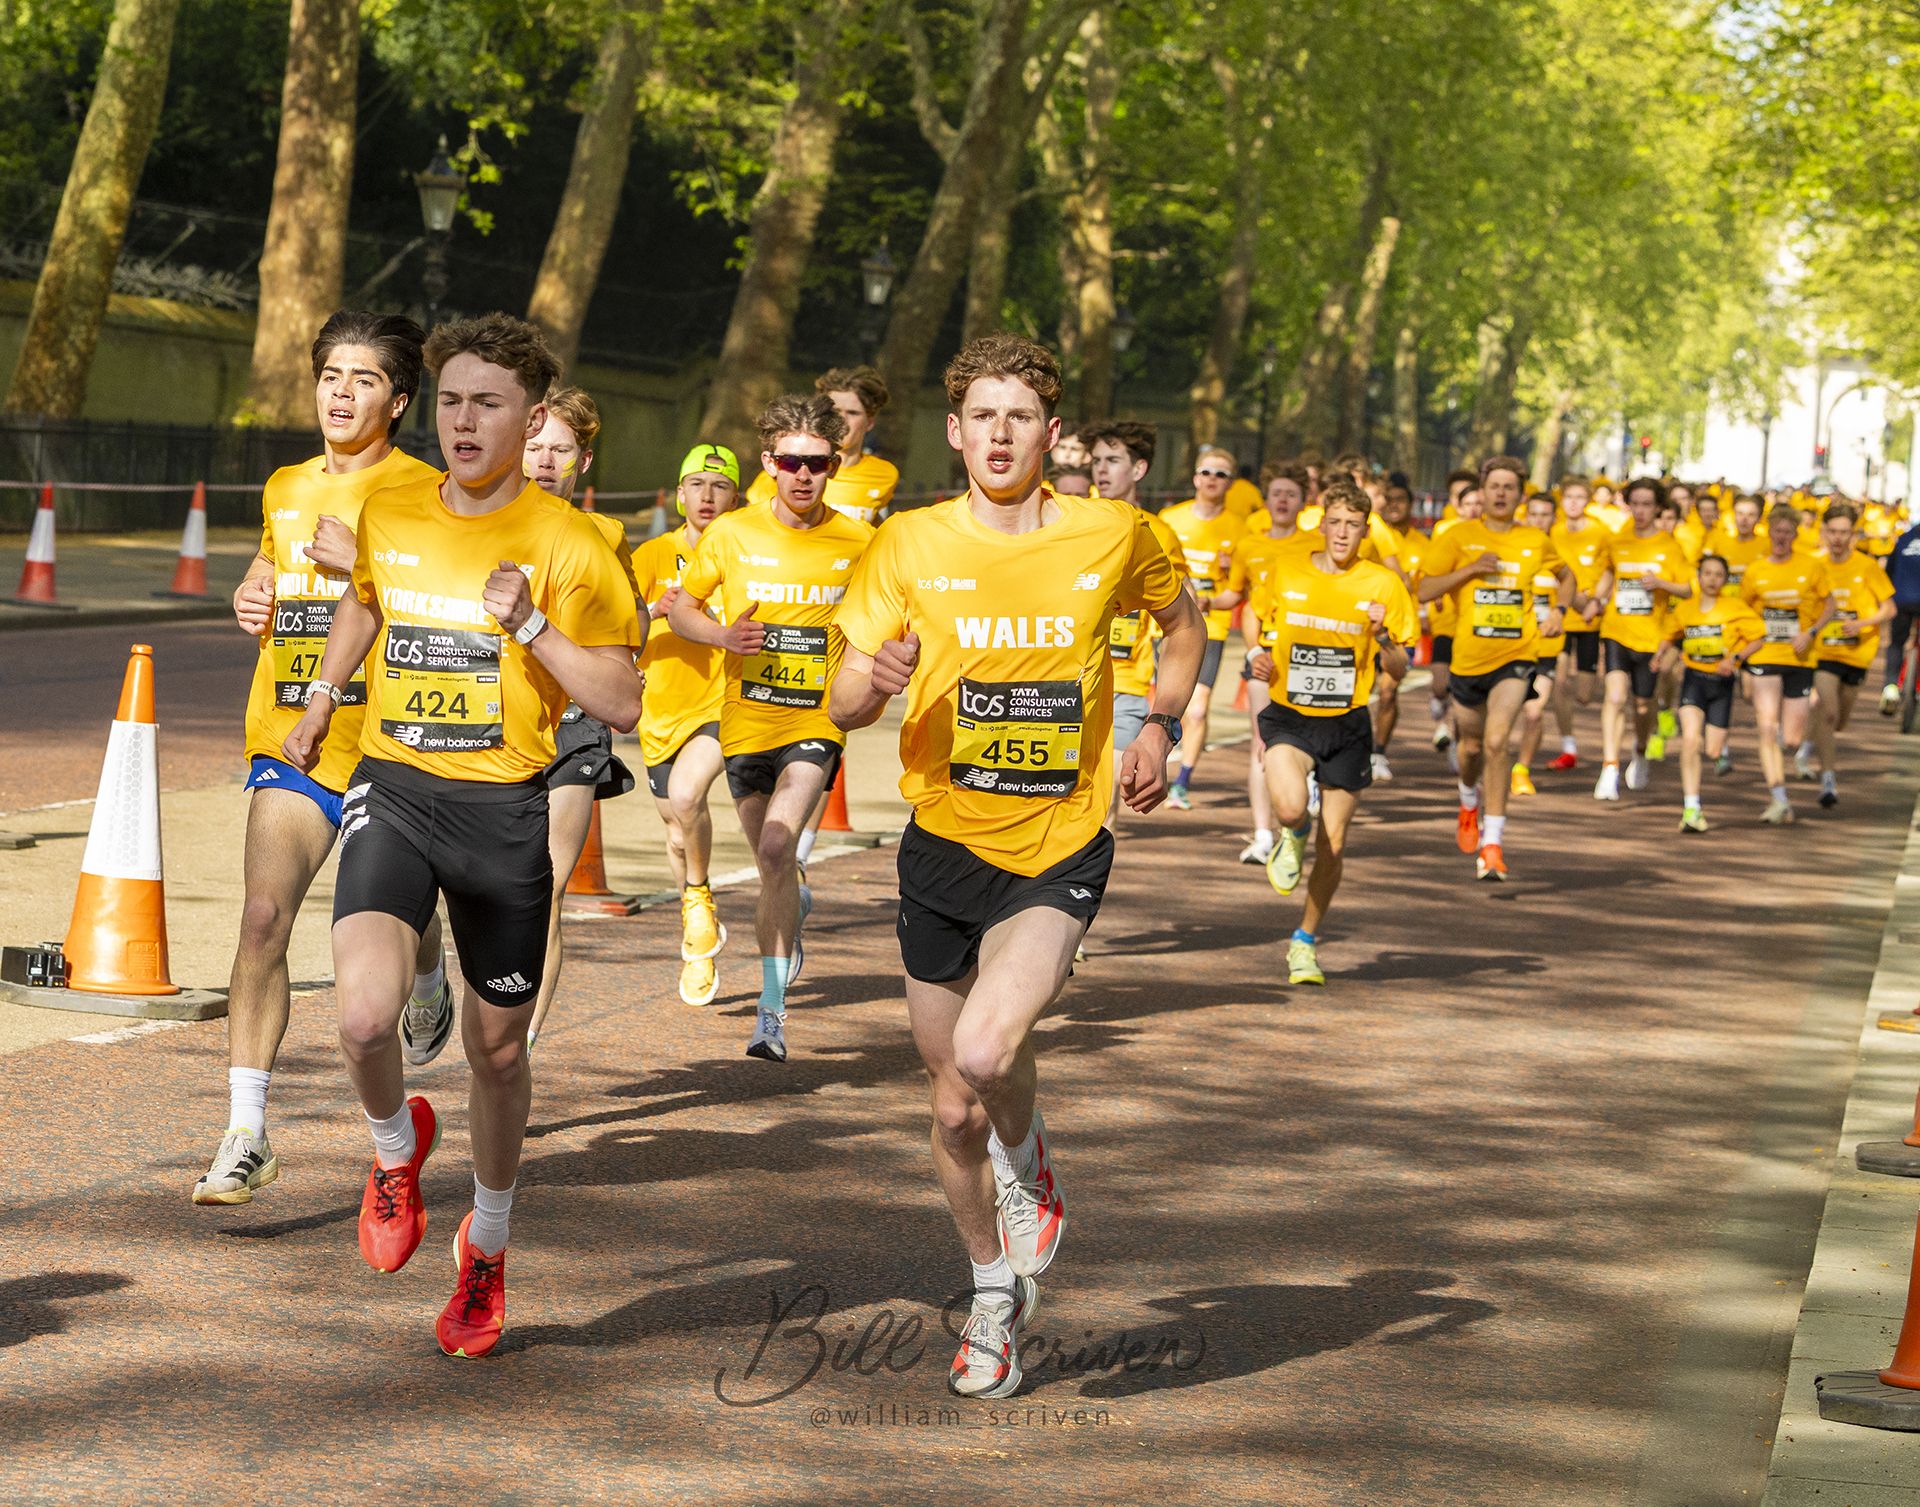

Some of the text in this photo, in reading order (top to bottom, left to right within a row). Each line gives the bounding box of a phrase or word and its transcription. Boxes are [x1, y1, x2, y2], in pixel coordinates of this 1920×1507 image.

[307, 606, 328, 614] TATA
[382, 585, 490, 626] YORKSHIRE
[276, 606, 304, 632] tcs
[780, 629, 802, 637] TATA
[954, 615, 1075, 649] WALES
[427, 635, 455, 647] TATA
[386, 632, 424, 665] tcs
[426, 645, 492, 658] CONSULTANCY
[290, 654, 325, 678] 47
[426, 656, 469, 667] SERVICES
[760, 664, 806, 686] 444
[1304, 676, 1336, 692] 376
[1010, 688, 1040, 697] TATA
[405, 690, 470, 719] 424
[962, 684, 1005, 717] tcs
[1009, 697, 1078, 707] CONSULTANCY
[1009, 708, 1053, 717] SERVICES
[423, 738, 446, 748] new
[447, 737, 492, 748] balance
[980, 739, 1049, 766] 455
[998, 782, 1020, 792] new
[1021, 782, 1066, 793] balance
[486, 979, 533, 993] adidas
